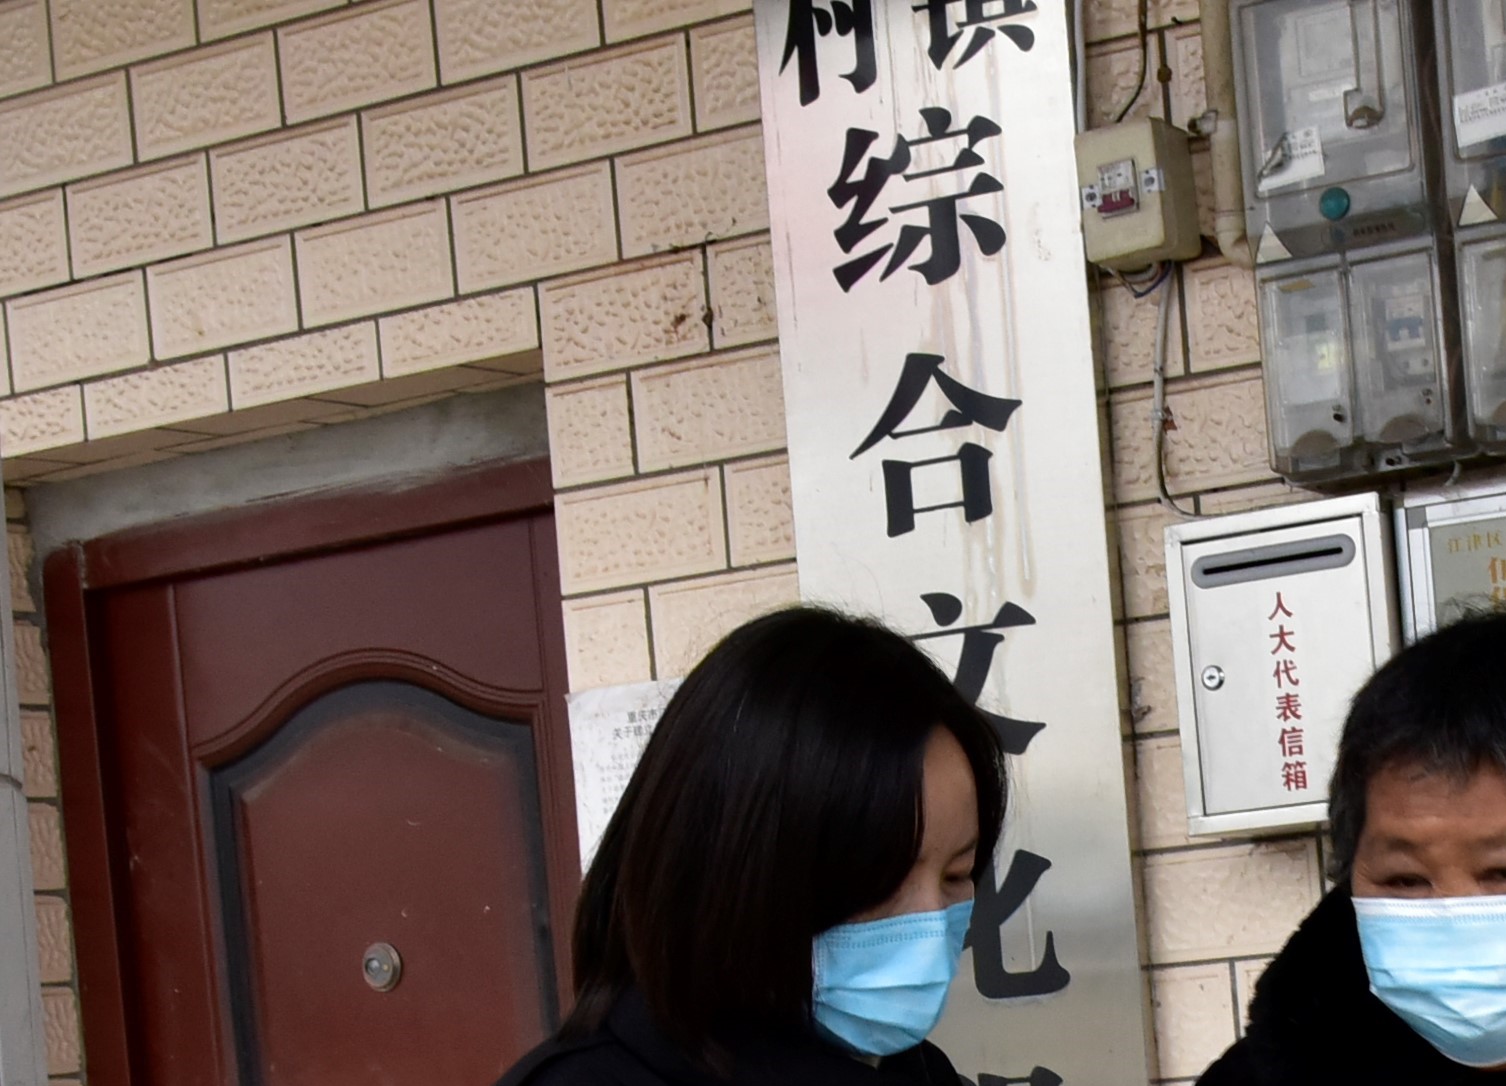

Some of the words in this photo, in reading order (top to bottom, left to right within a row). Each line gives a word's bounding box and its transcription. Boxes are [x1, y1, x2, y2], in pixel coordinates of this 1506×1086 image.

[1268, 591, 1308, 792] 人大代表信箱
